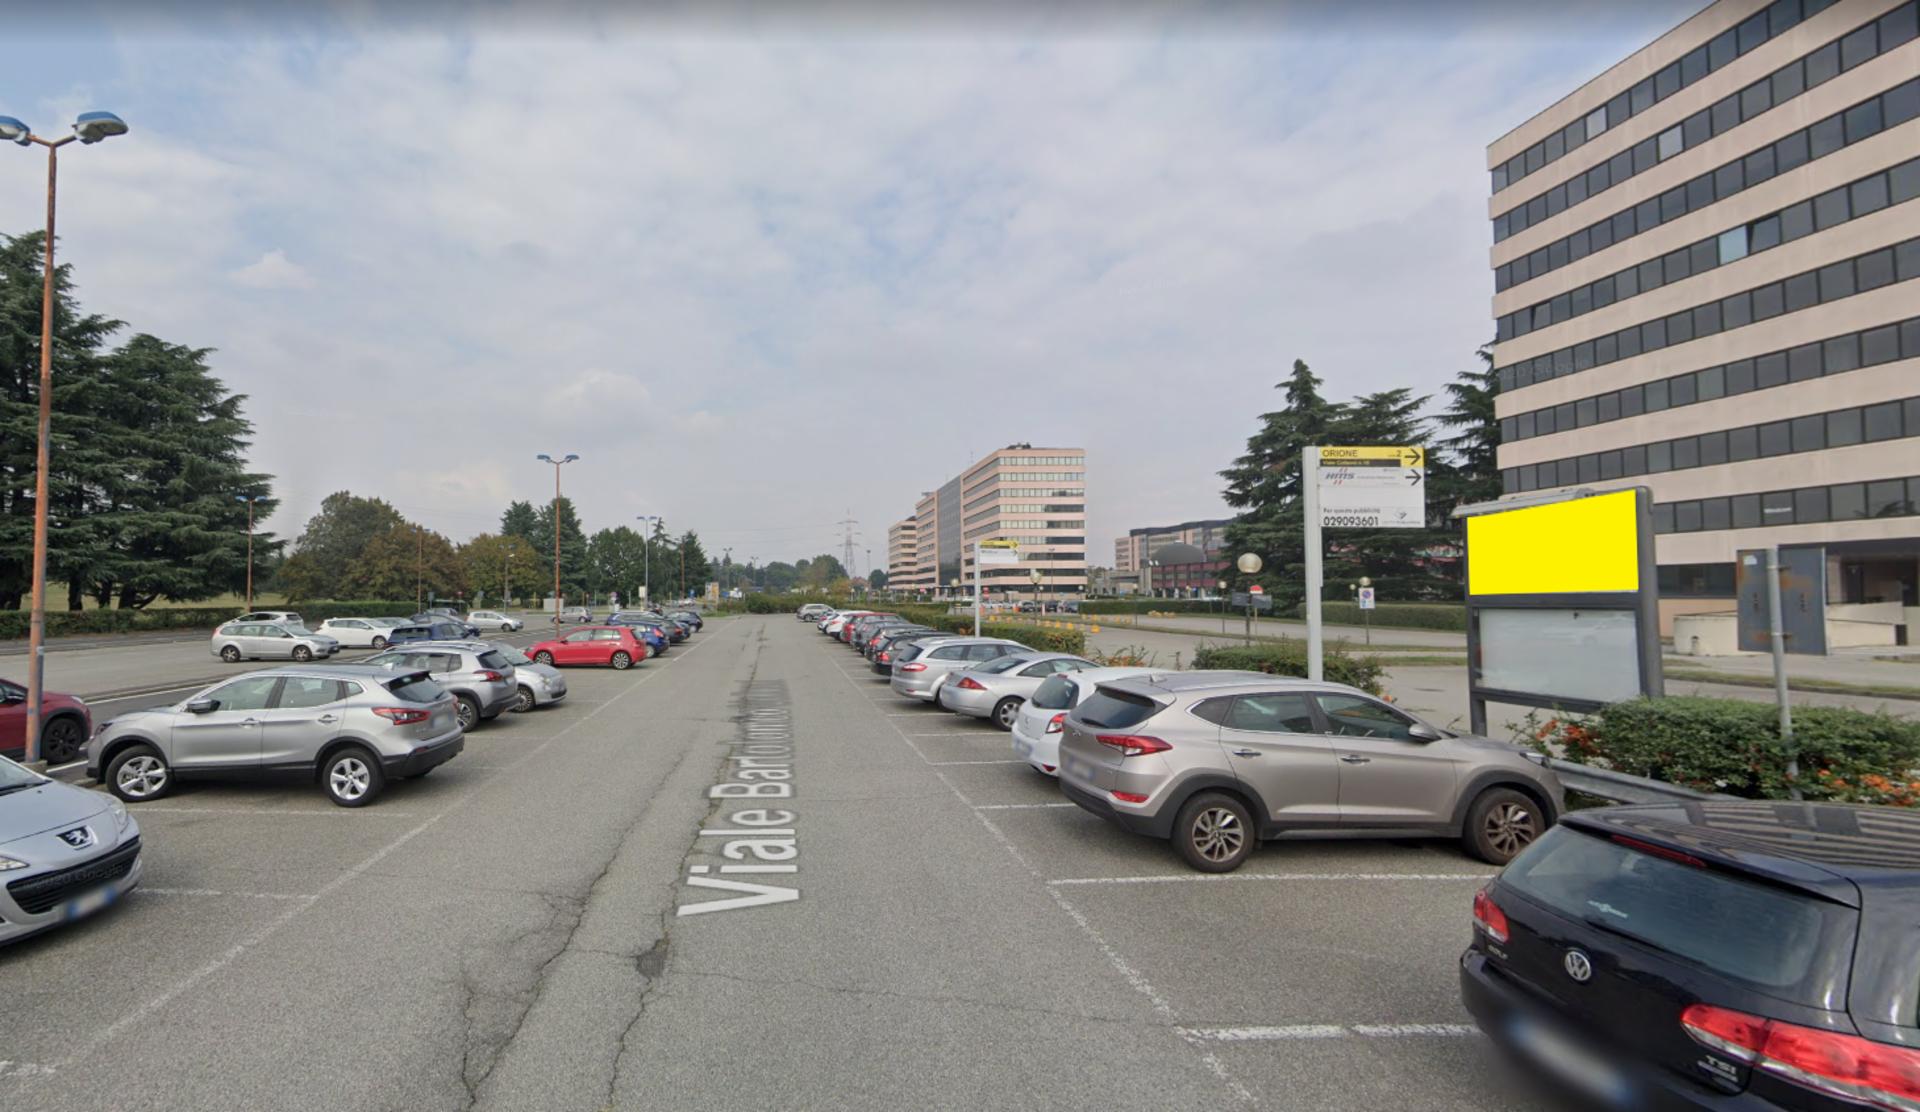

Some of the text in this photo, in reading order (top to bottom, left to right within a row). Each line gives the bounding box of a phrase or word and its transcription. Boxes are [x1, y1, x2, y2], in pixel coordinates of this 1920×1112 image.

[1322, 449, 1358, 457] ORIONE
[1323, 516, 1379, 526] 029093601
[1705, 1054, 1737, 1075] TSI
